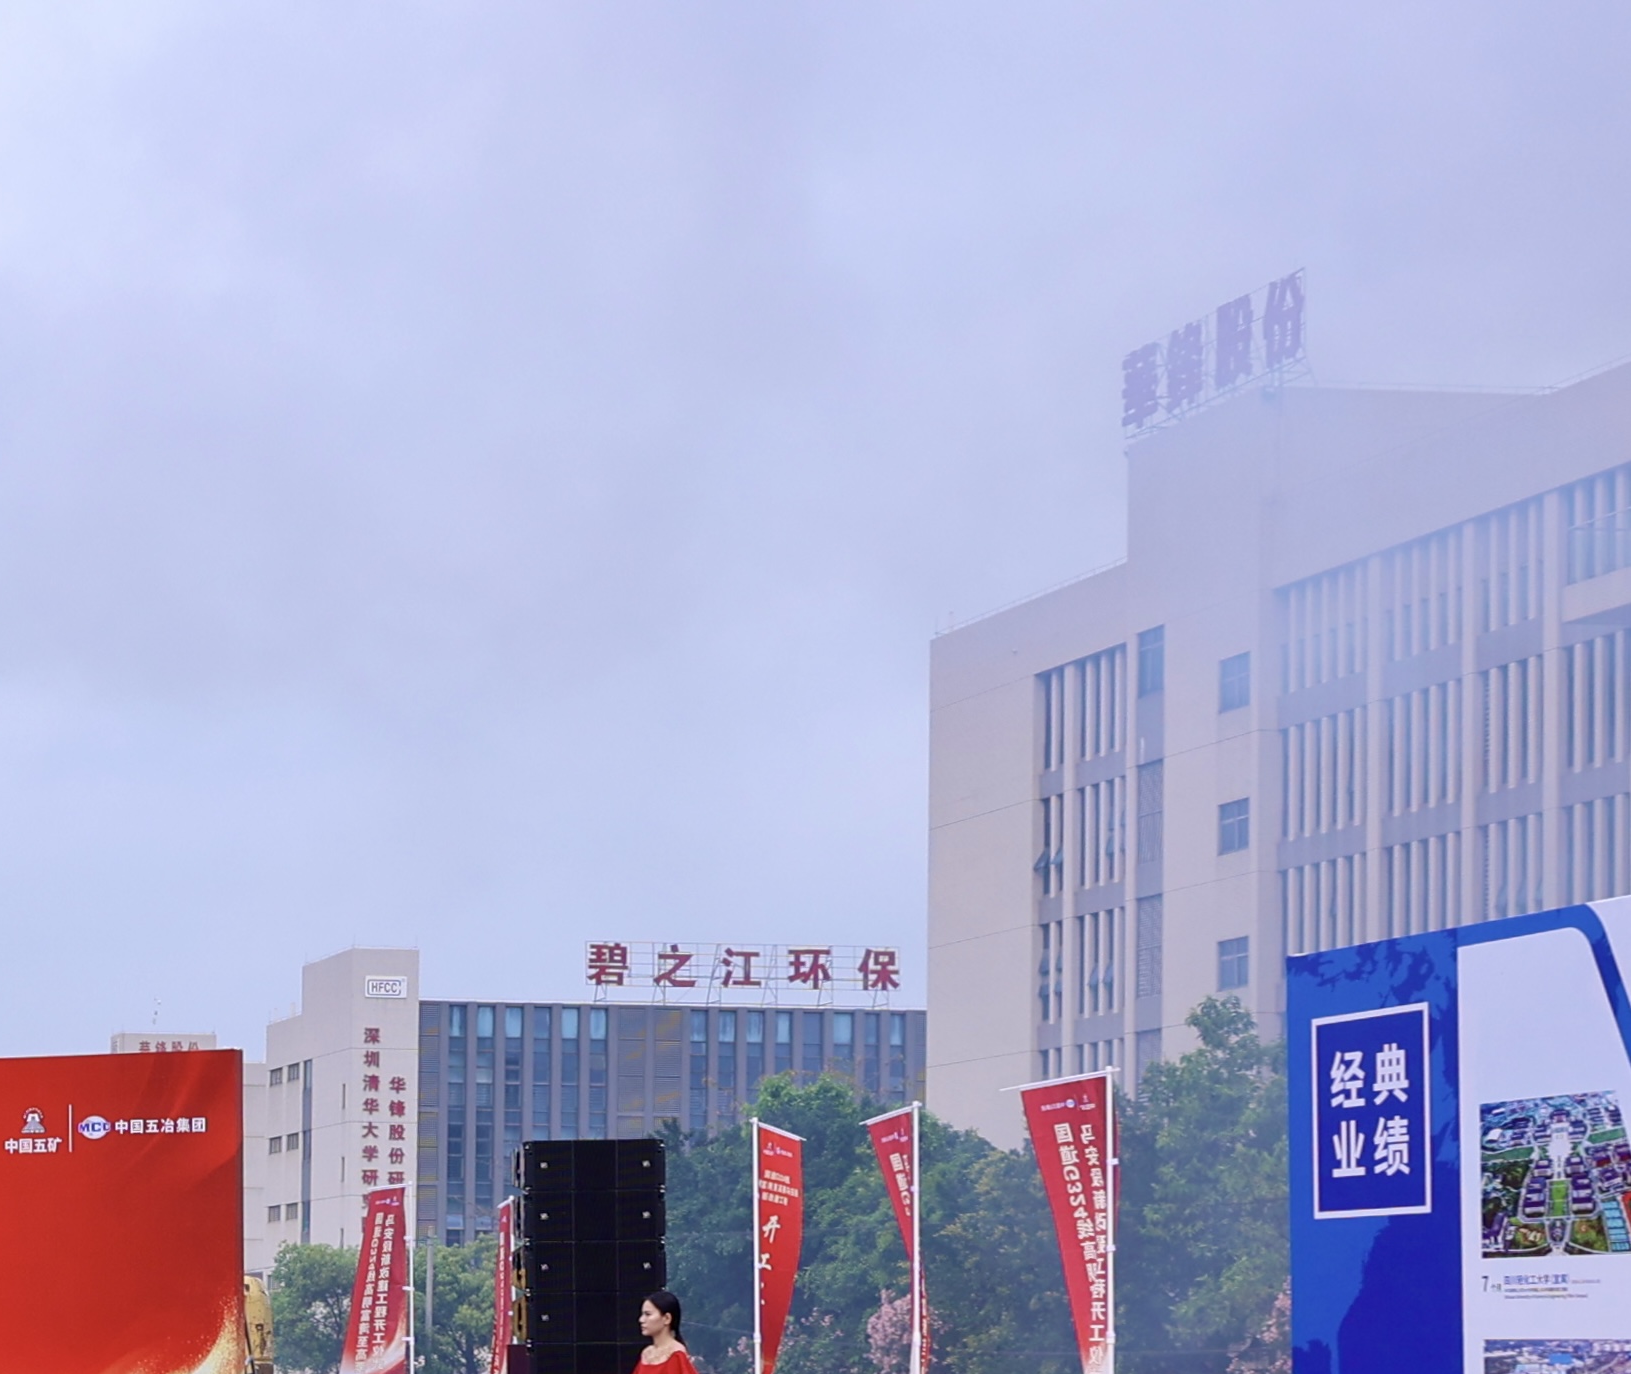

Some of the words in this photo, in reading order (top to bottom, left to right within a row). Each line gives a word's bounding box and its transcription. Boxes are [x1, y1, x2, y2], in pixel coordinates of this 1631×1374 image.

[370, 981, 398, 994] HFCC
[587, 942, 900, 991] 碧之江环保
[1330, 1042, 1410, 1109] 经典
[114, 1117, 207, 1135] 中国五冶集团
[361, 1028, 380, 1209] 深圳清华大学研
[4, 1137, 63, 1154] 中国五矿
[1331, 1115, 1411, 1178] 业绩
